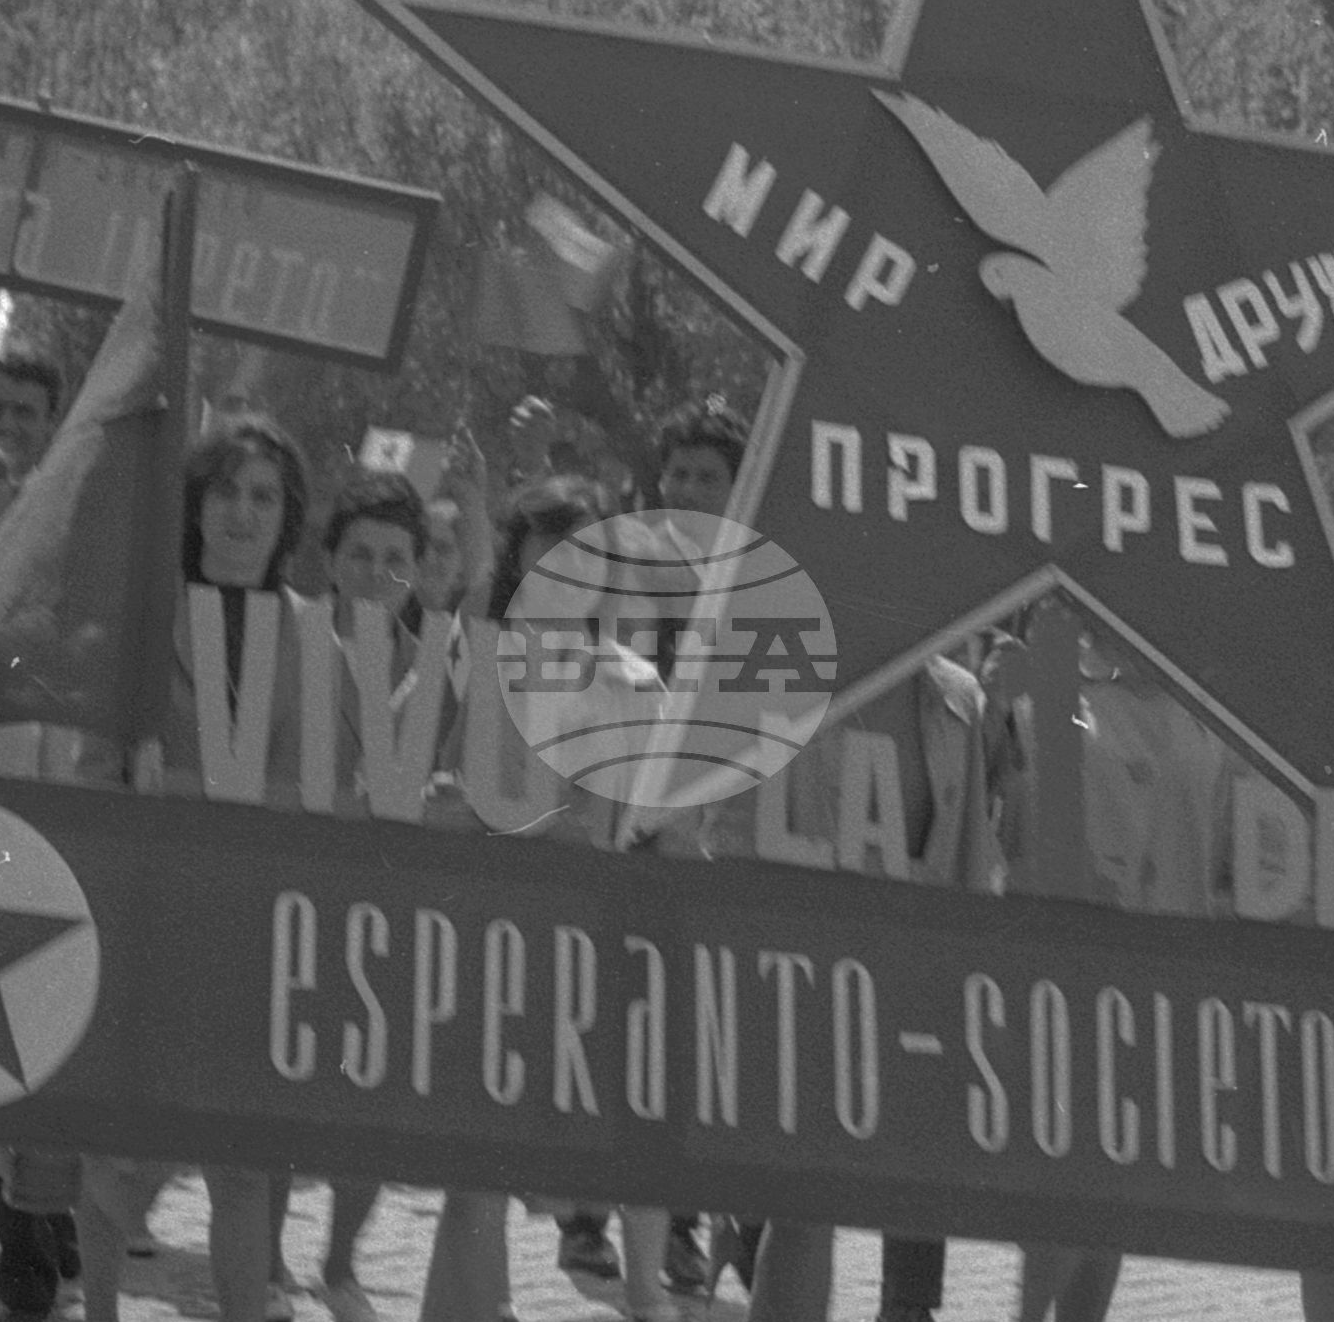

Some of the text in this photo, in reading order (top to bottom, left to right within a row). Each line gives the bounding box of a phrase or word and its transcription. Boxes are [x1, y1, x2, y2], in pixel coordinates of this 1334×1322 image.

[702, 141, 917, 312] МИР
[810, 419, 1296, 569] ПРОГРЕС
[186, 581, 559, 837] VIVU
[755, 709, 911, 880] LA
